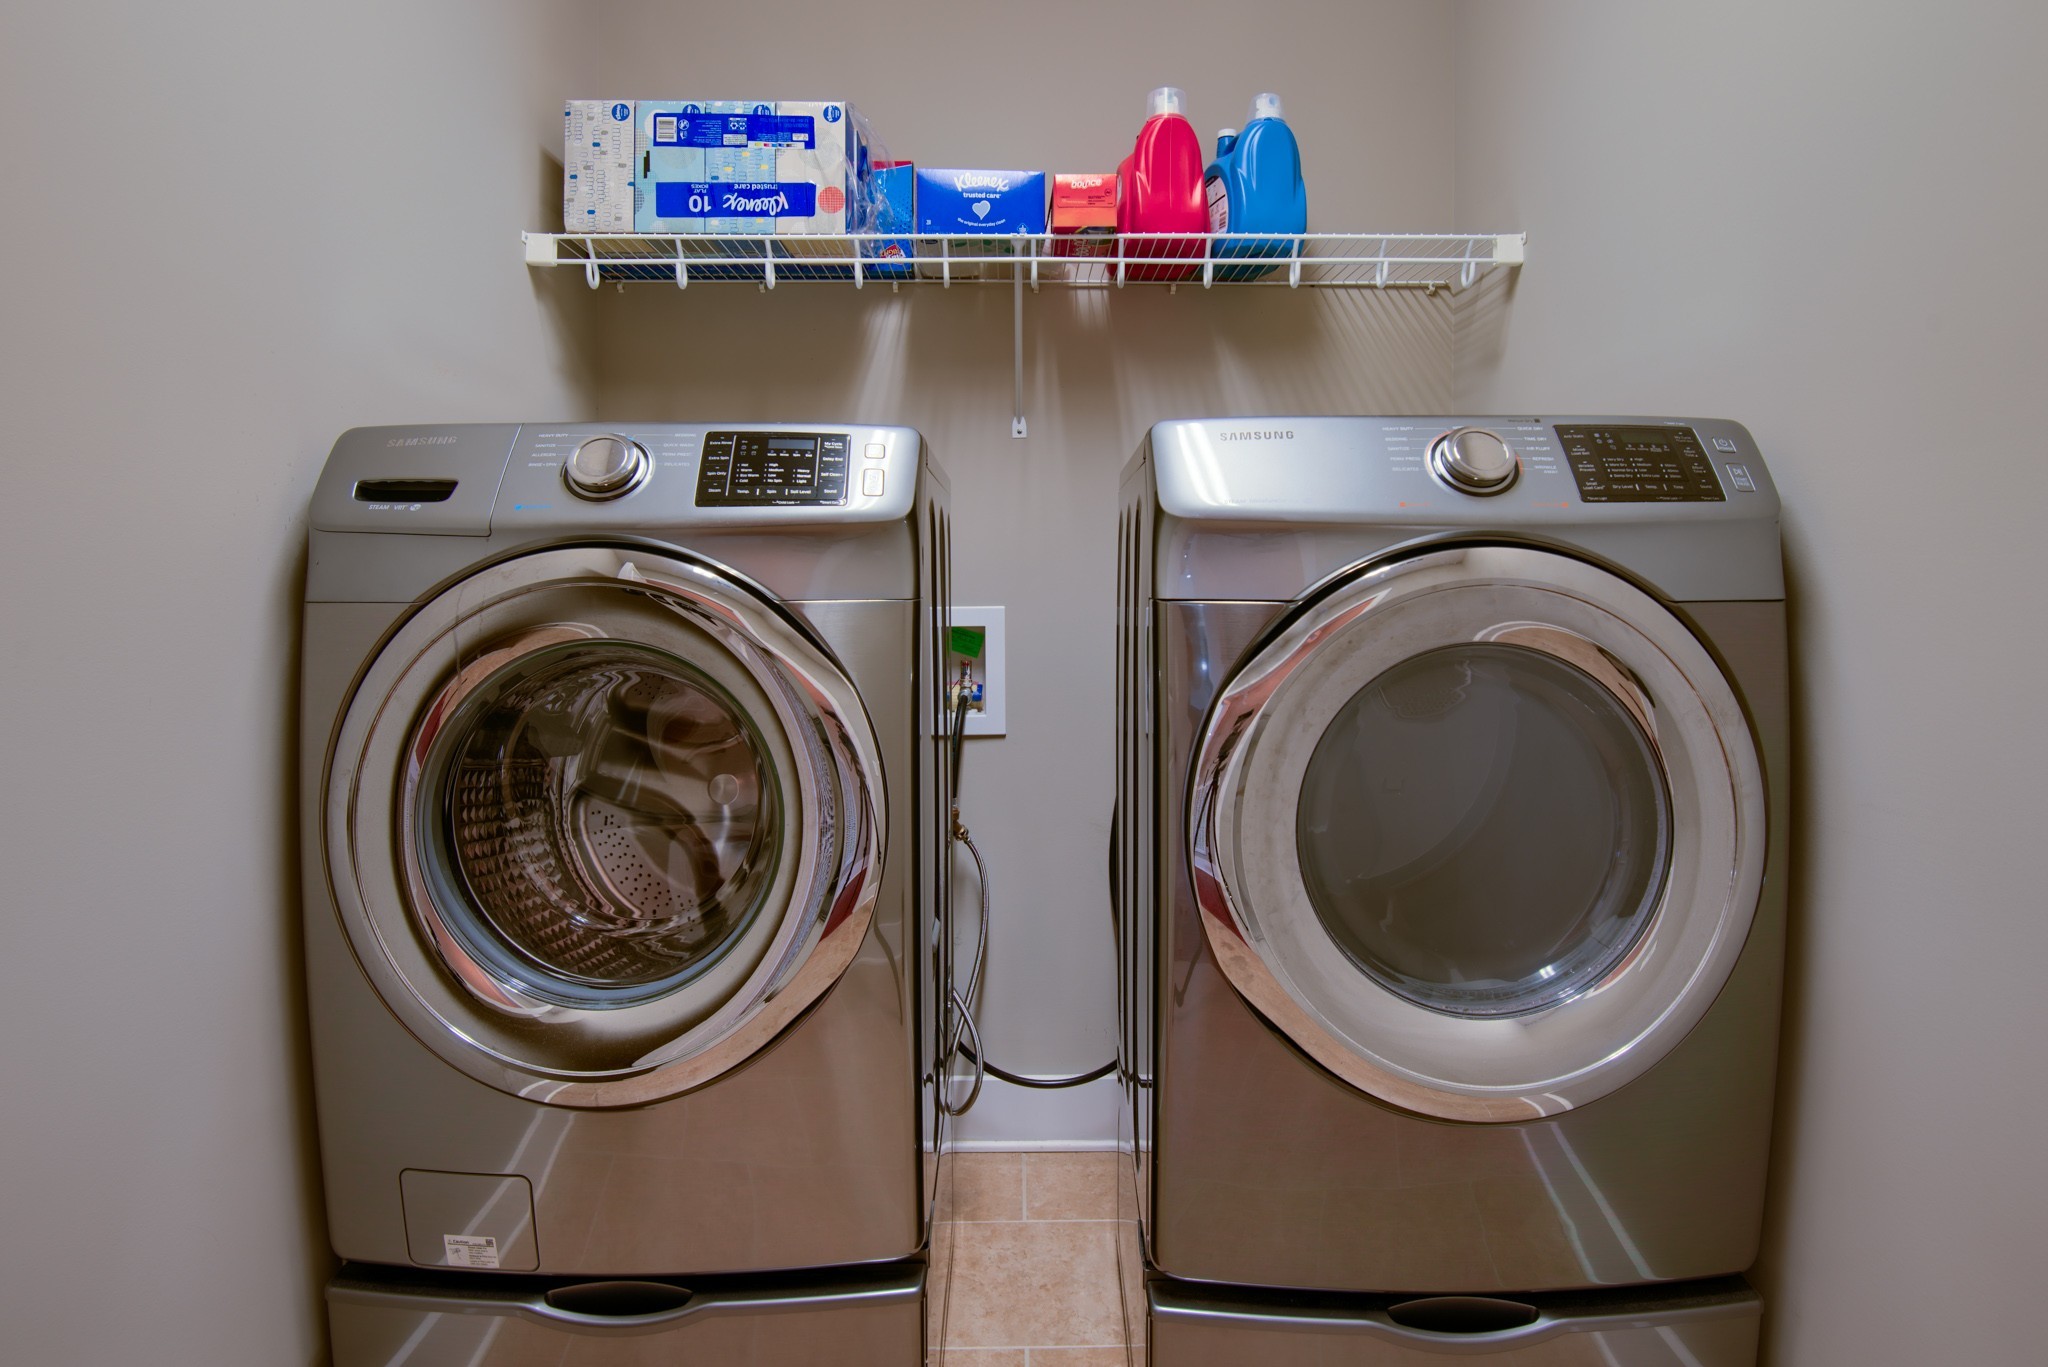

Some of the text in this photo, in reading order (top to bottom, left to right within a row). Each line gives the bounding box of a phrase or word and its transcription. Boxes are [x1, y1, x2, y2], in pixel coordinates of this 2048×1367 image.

[752, 183, 778, 191] trusted
[954, 172, 1010, 192] Kleenex
[1071, 179, 1102, 189] bounce
[688, 195, 712, 212] 10
[722, 191, 789, 216] Kleenex
[1220, 430, 1294, 441] SAMSUNG
[386, 436, 458, 448] SAMSUNG
